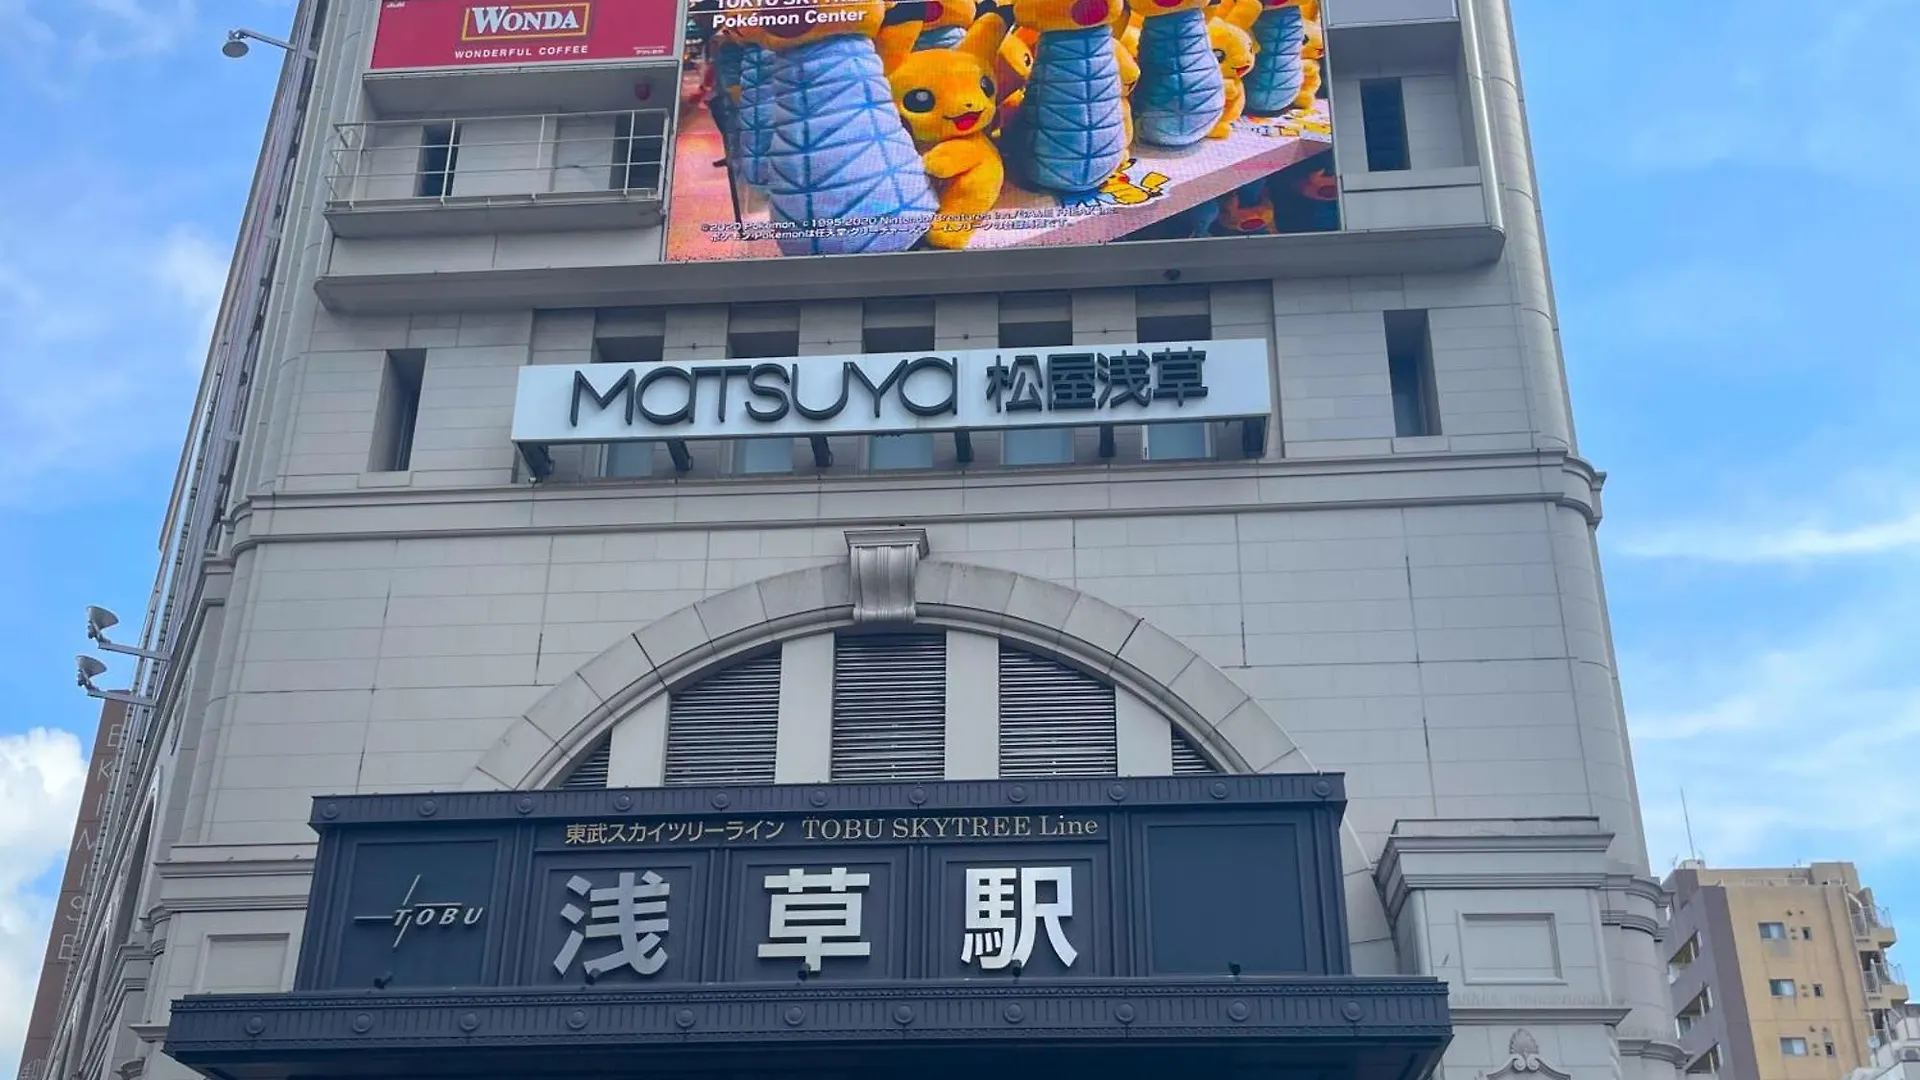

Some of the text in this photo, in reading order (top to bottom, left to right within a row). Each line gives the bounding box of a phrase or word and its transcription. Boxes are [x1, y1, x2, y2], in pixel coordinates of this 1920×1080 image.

[472, 6, 579, 33] WONDA
[713, 9, 868, 29] Pokémon Center
[455, 45, 590, 59] WONDERFUL COFFEE
[986, 346, 1208, 413] 松屋浅草
[565, 813, 1099, 845] 東武スカイツリーライン TOBU SKYTREE Line
[393, 905, 484, 928] TOBU
[553, 866, 1078, 977] 浅草駅
